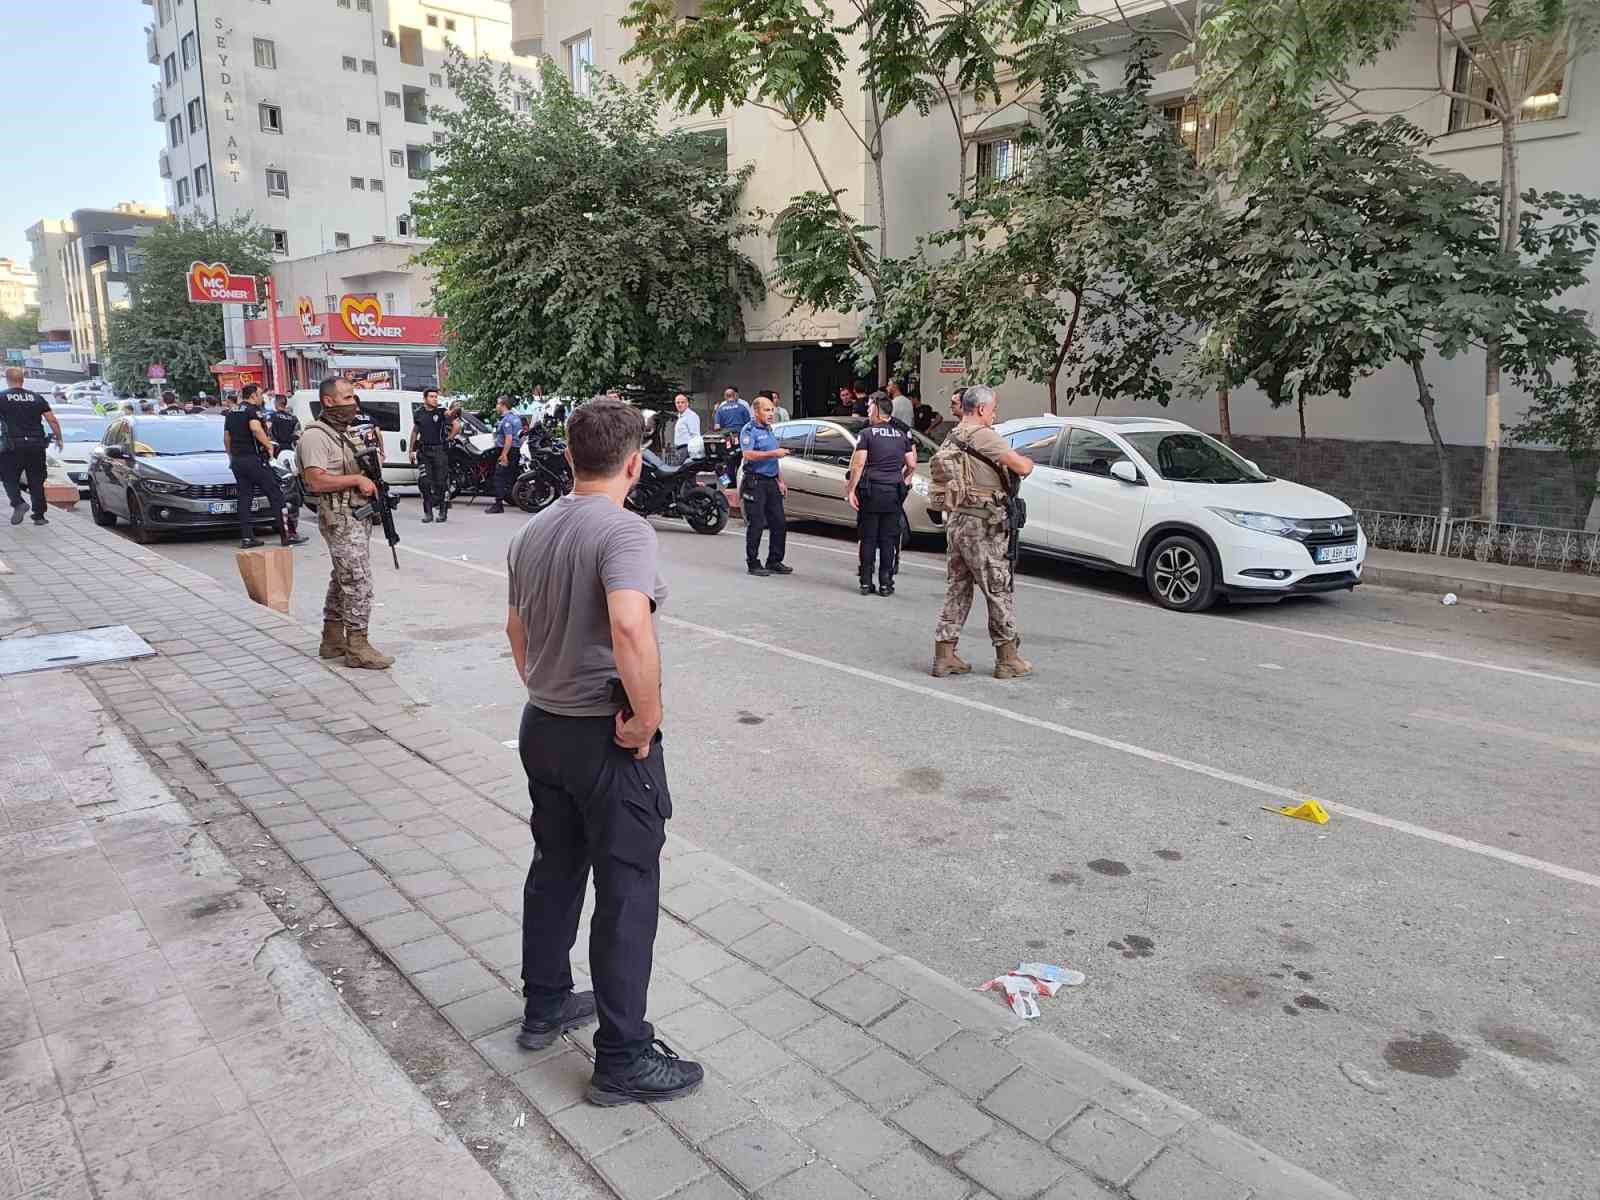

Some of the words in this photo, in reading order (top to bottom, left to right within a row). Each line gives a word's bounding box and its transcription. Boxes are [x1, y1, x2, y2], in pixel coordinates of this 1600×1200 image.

[214, 16, 234, 121] SEYDAL
[227, 135, 241, 183] APT
[203, 276, 224, 289] MC
[350, 312, 376, 326] MC
